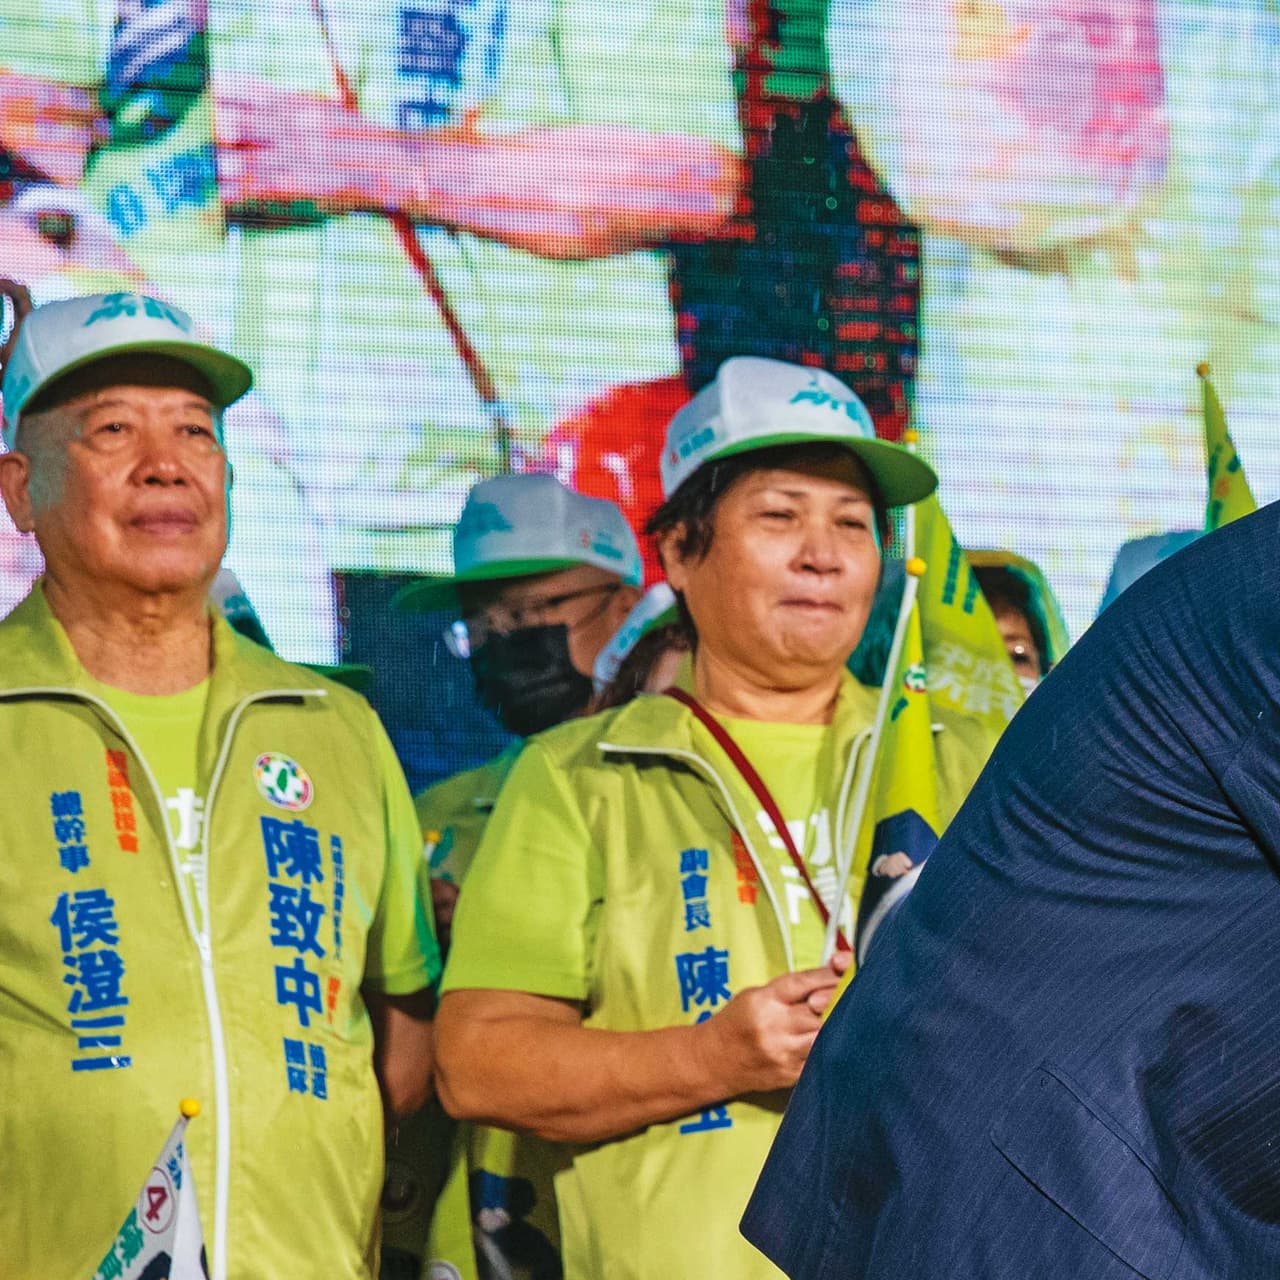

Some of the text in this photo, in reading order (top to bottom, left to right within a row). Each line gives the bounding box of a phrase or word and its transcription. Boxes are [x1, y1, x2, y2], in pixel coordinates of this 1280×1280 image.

[50, 888, 132, 1072] 侯澄三
[260, 815, 326, 1028] 陳致中
